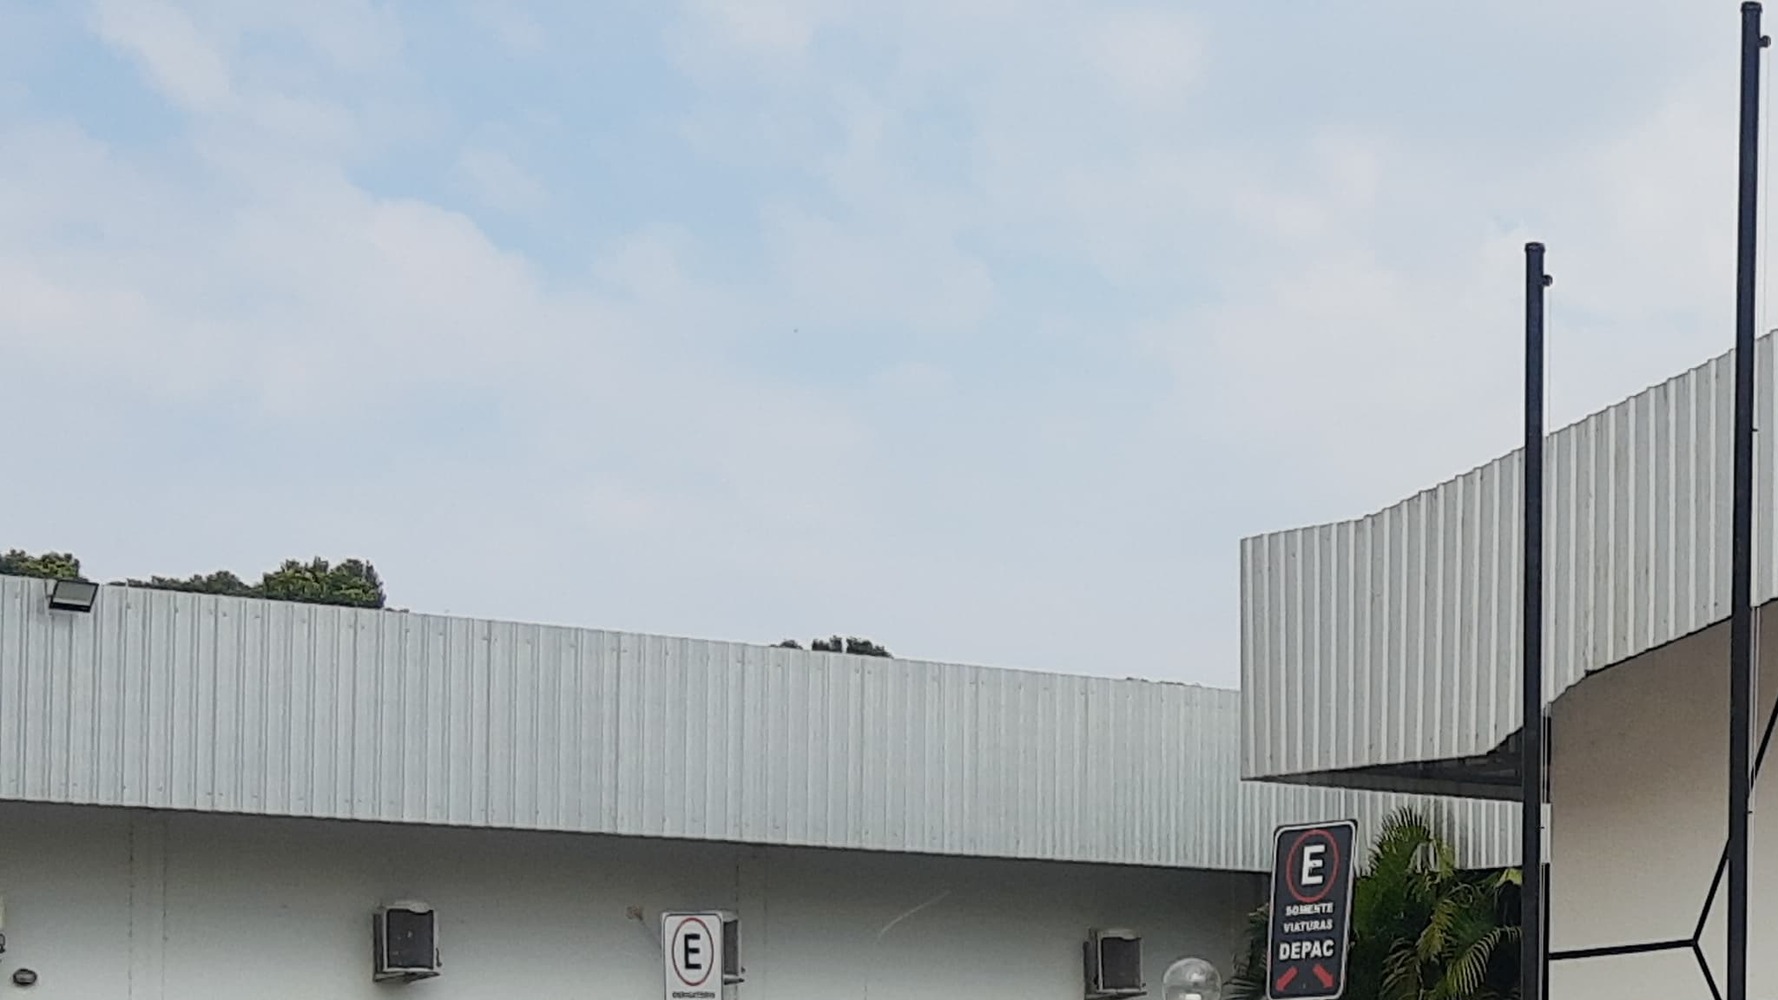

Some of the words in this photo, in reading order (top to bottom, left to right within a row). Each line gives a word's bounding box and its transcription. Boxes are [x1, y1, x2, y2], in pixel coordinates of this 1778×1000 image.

[1301, 844, 1325, 885] E
[1285, 902, 1334, 917] SOMENTE
[1283, 918, 1333, 934] VIATURAS
[684, 933, 702, 970] E
[1278, 939, 1335, 961] DEPAC
